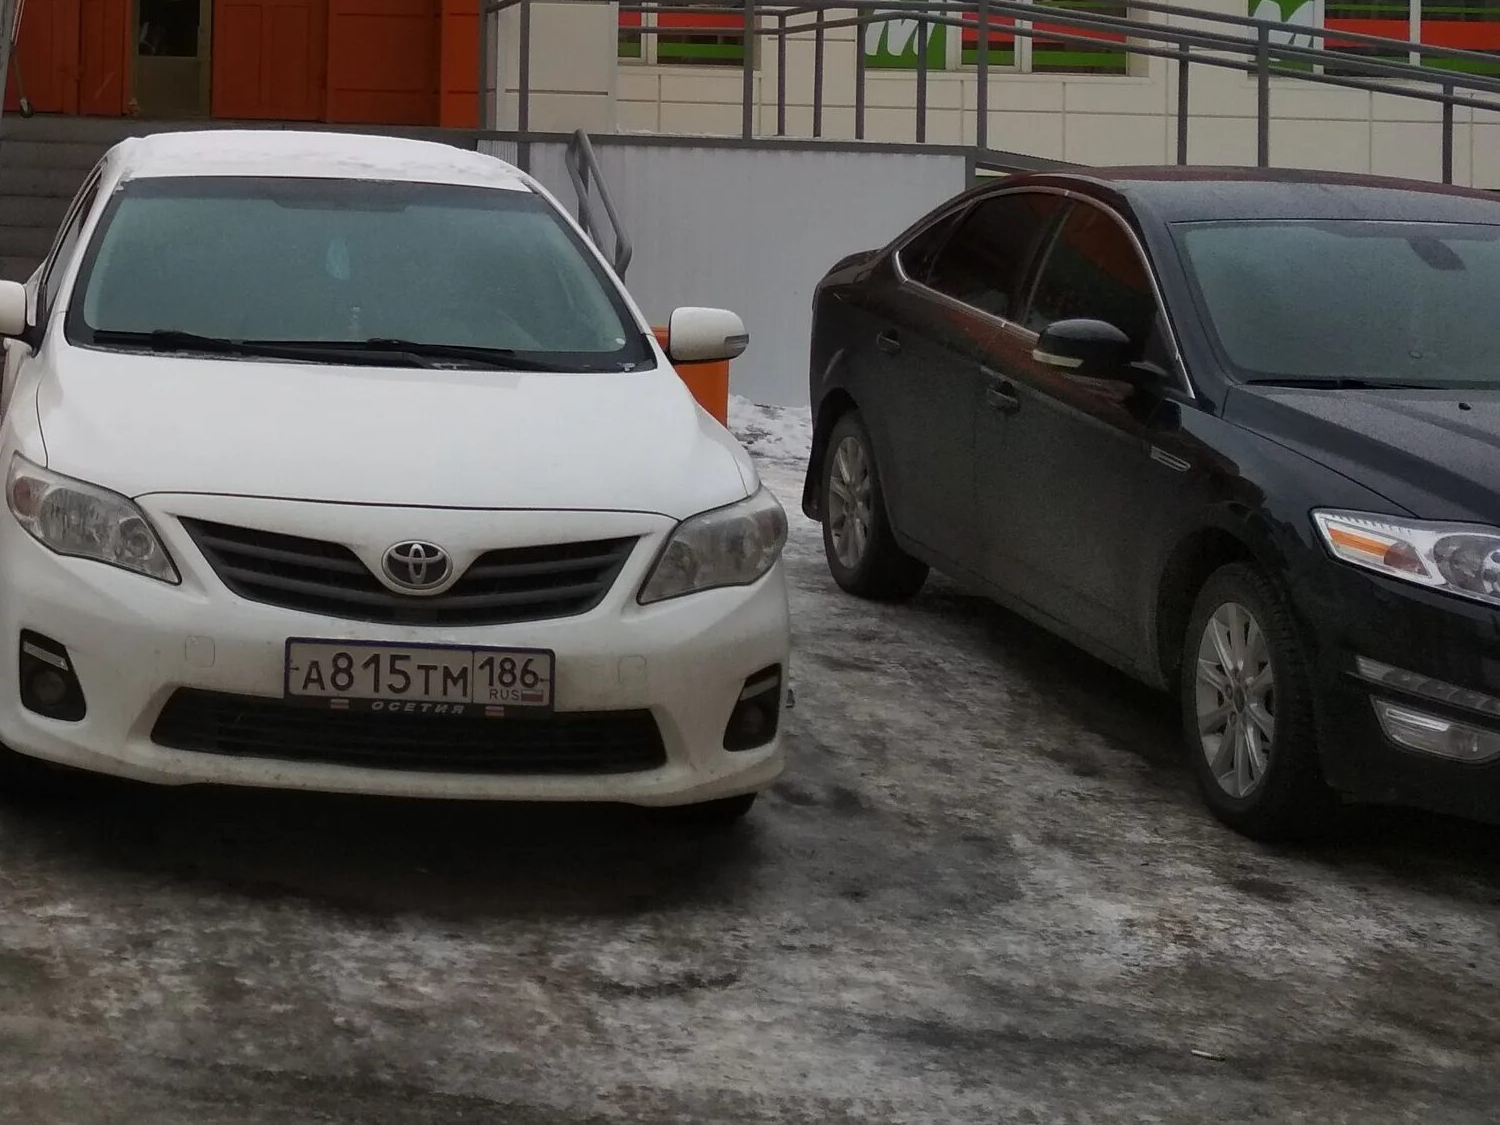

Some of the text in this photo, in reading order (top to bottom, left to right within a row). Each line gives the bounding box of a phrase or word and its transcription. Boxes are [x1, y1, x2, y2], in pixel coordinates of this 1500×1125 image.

[478, 656, 540, 689] 186
[489, 689, 520, 701] RUS
[371, 700, 466, 715] ОСЕТИЯ
